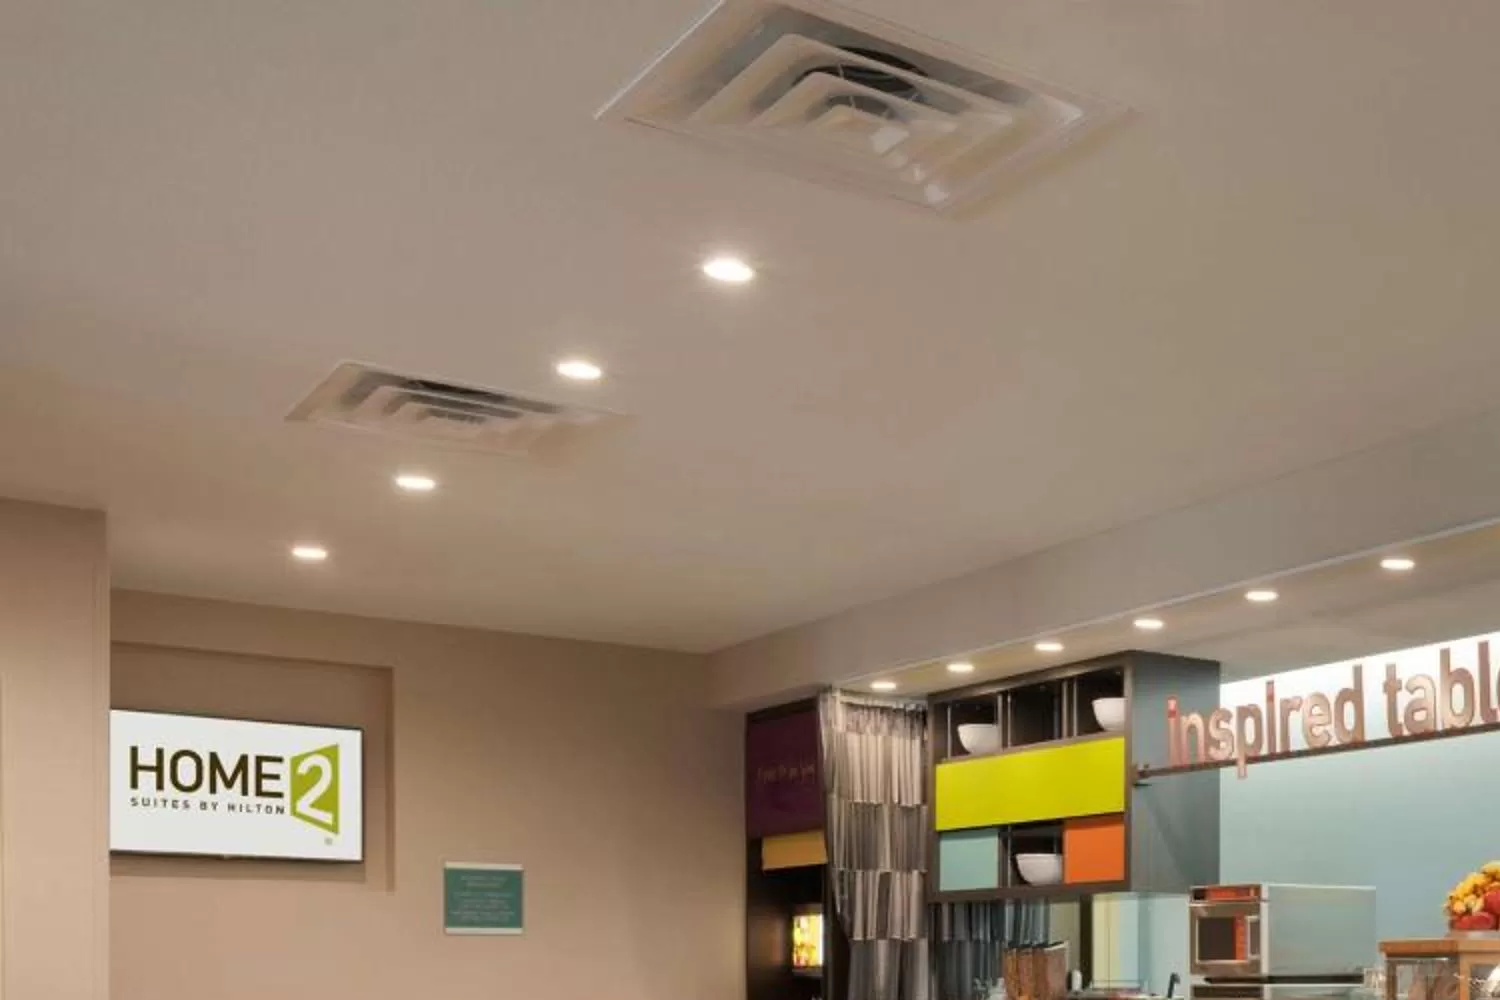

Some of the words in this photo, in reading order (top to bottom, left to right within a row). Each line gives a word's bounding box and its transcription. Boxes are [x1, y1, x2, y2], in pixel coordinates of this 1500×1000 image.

[1166, 664, 1365, 779] inspired
[129, 745, 285, 799] HOME
[295, 752, 336, 828] 2
[130, 796, 191, 810] SUITES
[199, 801, 219, 812] BY
[226, 803, 286, 816] HILTON
